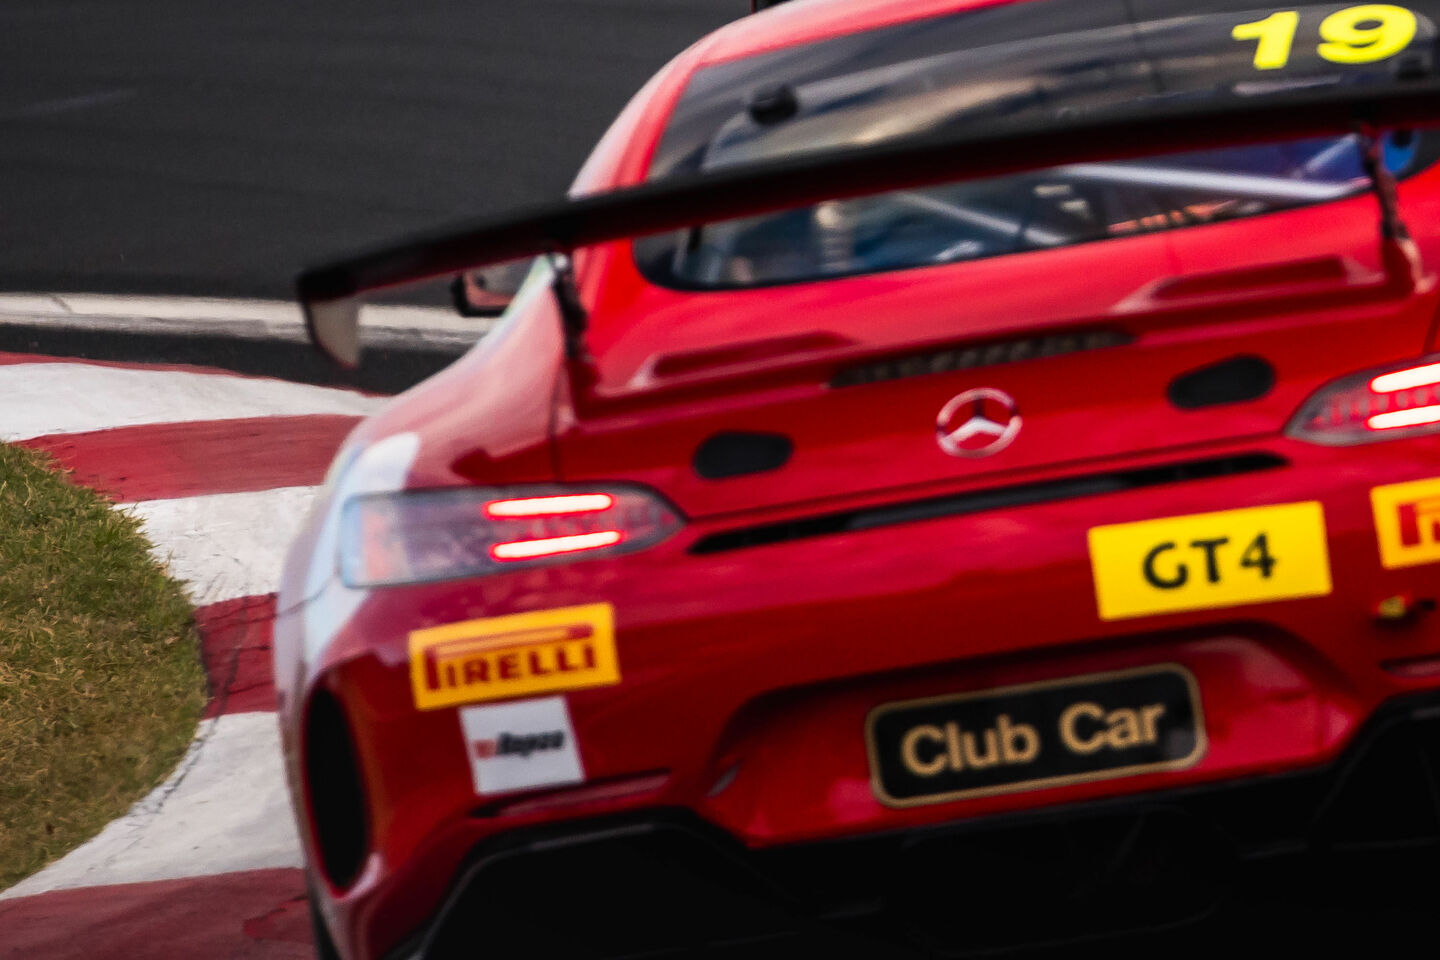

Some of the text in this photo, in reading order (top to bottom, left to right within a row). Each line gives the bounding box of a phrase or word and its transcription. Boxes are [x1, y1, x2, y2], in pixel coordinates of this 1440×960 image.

[1231, 3, 1418, 70] 19
[1142, 532, 1278, 590] GT4
[423, 623, 596, 691] PIRELLI
[901, 701, 1166, 777] Club Car
